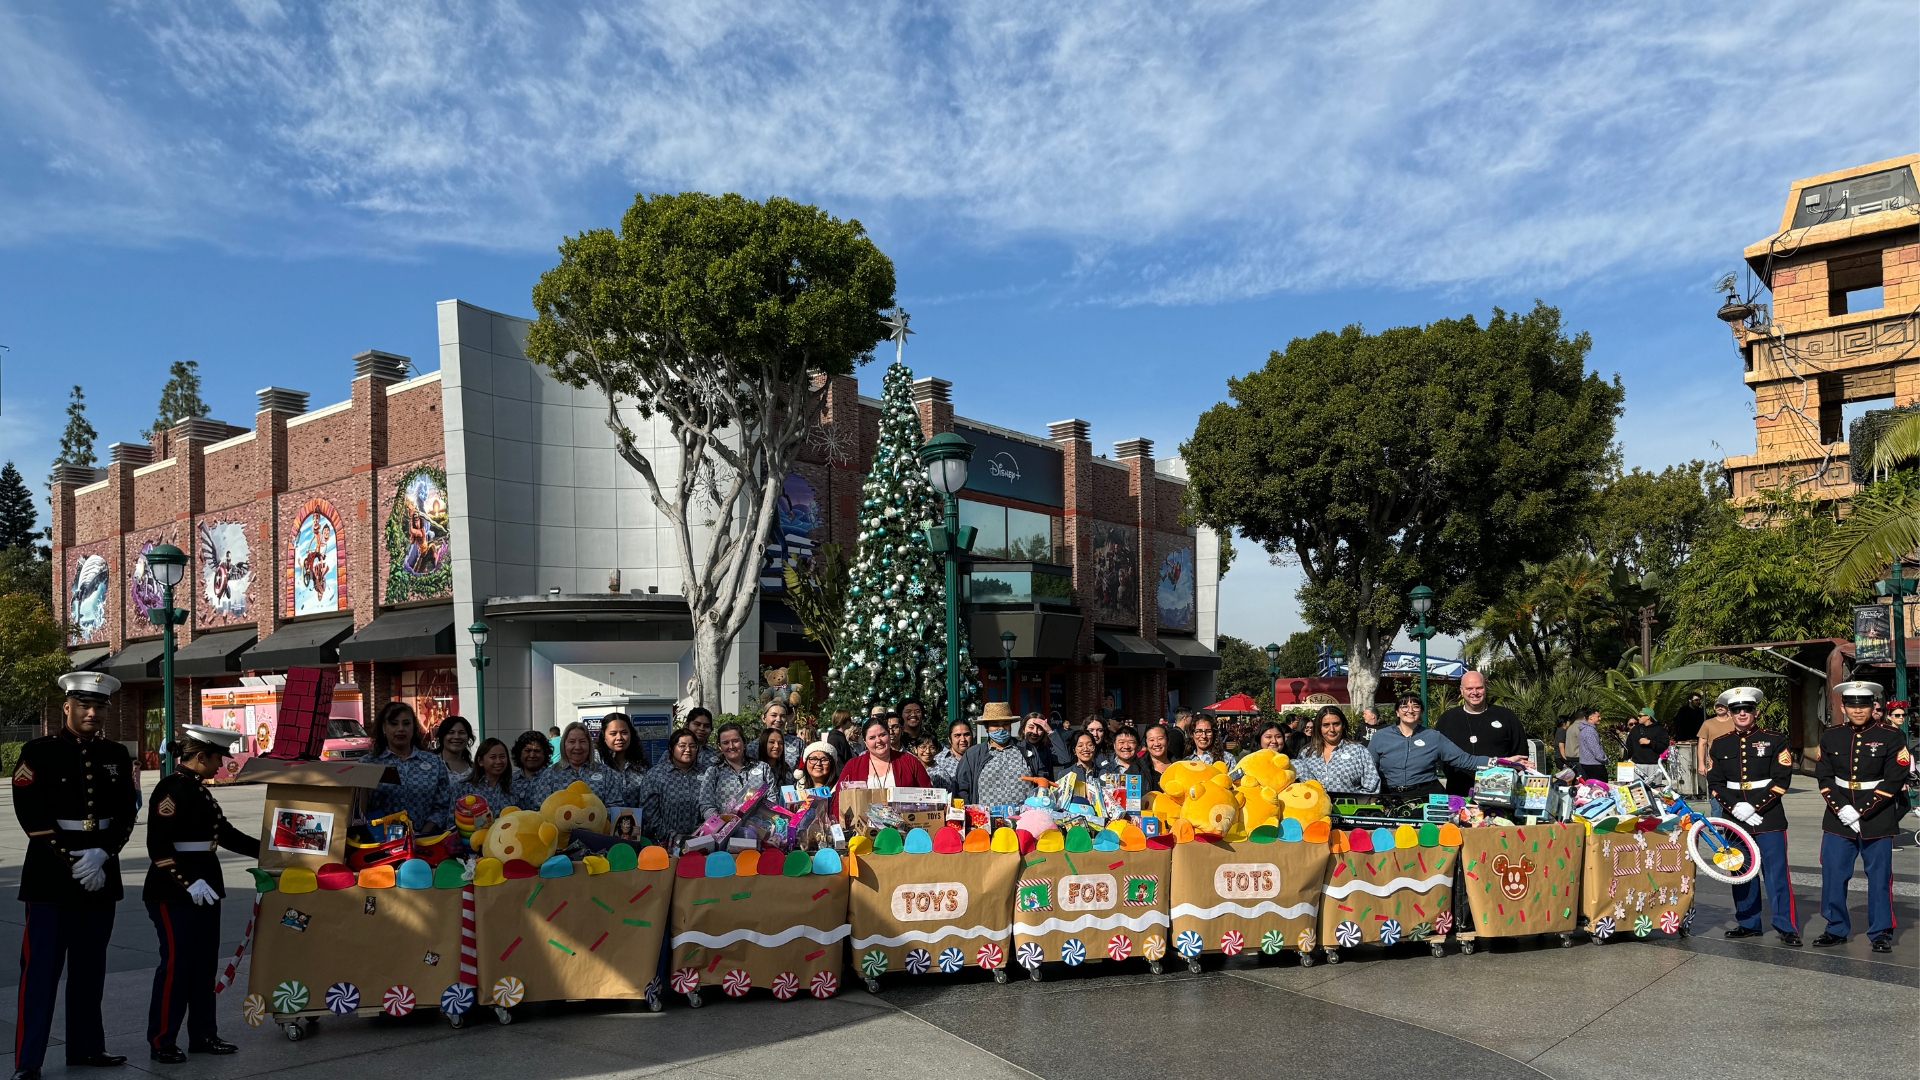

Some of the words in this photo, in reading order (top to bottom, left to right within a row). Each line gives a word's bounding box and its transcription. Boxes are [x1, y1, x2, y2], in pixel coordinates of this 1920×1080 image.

[1403, 657, 1437, 673] Disey
[926, 812, 942, 820] TOYS
[1223, 870, 1273, 892] TOTS
[902, 889, 958, 914] TOYS
[1068, 882, 1110, 904] FOR
